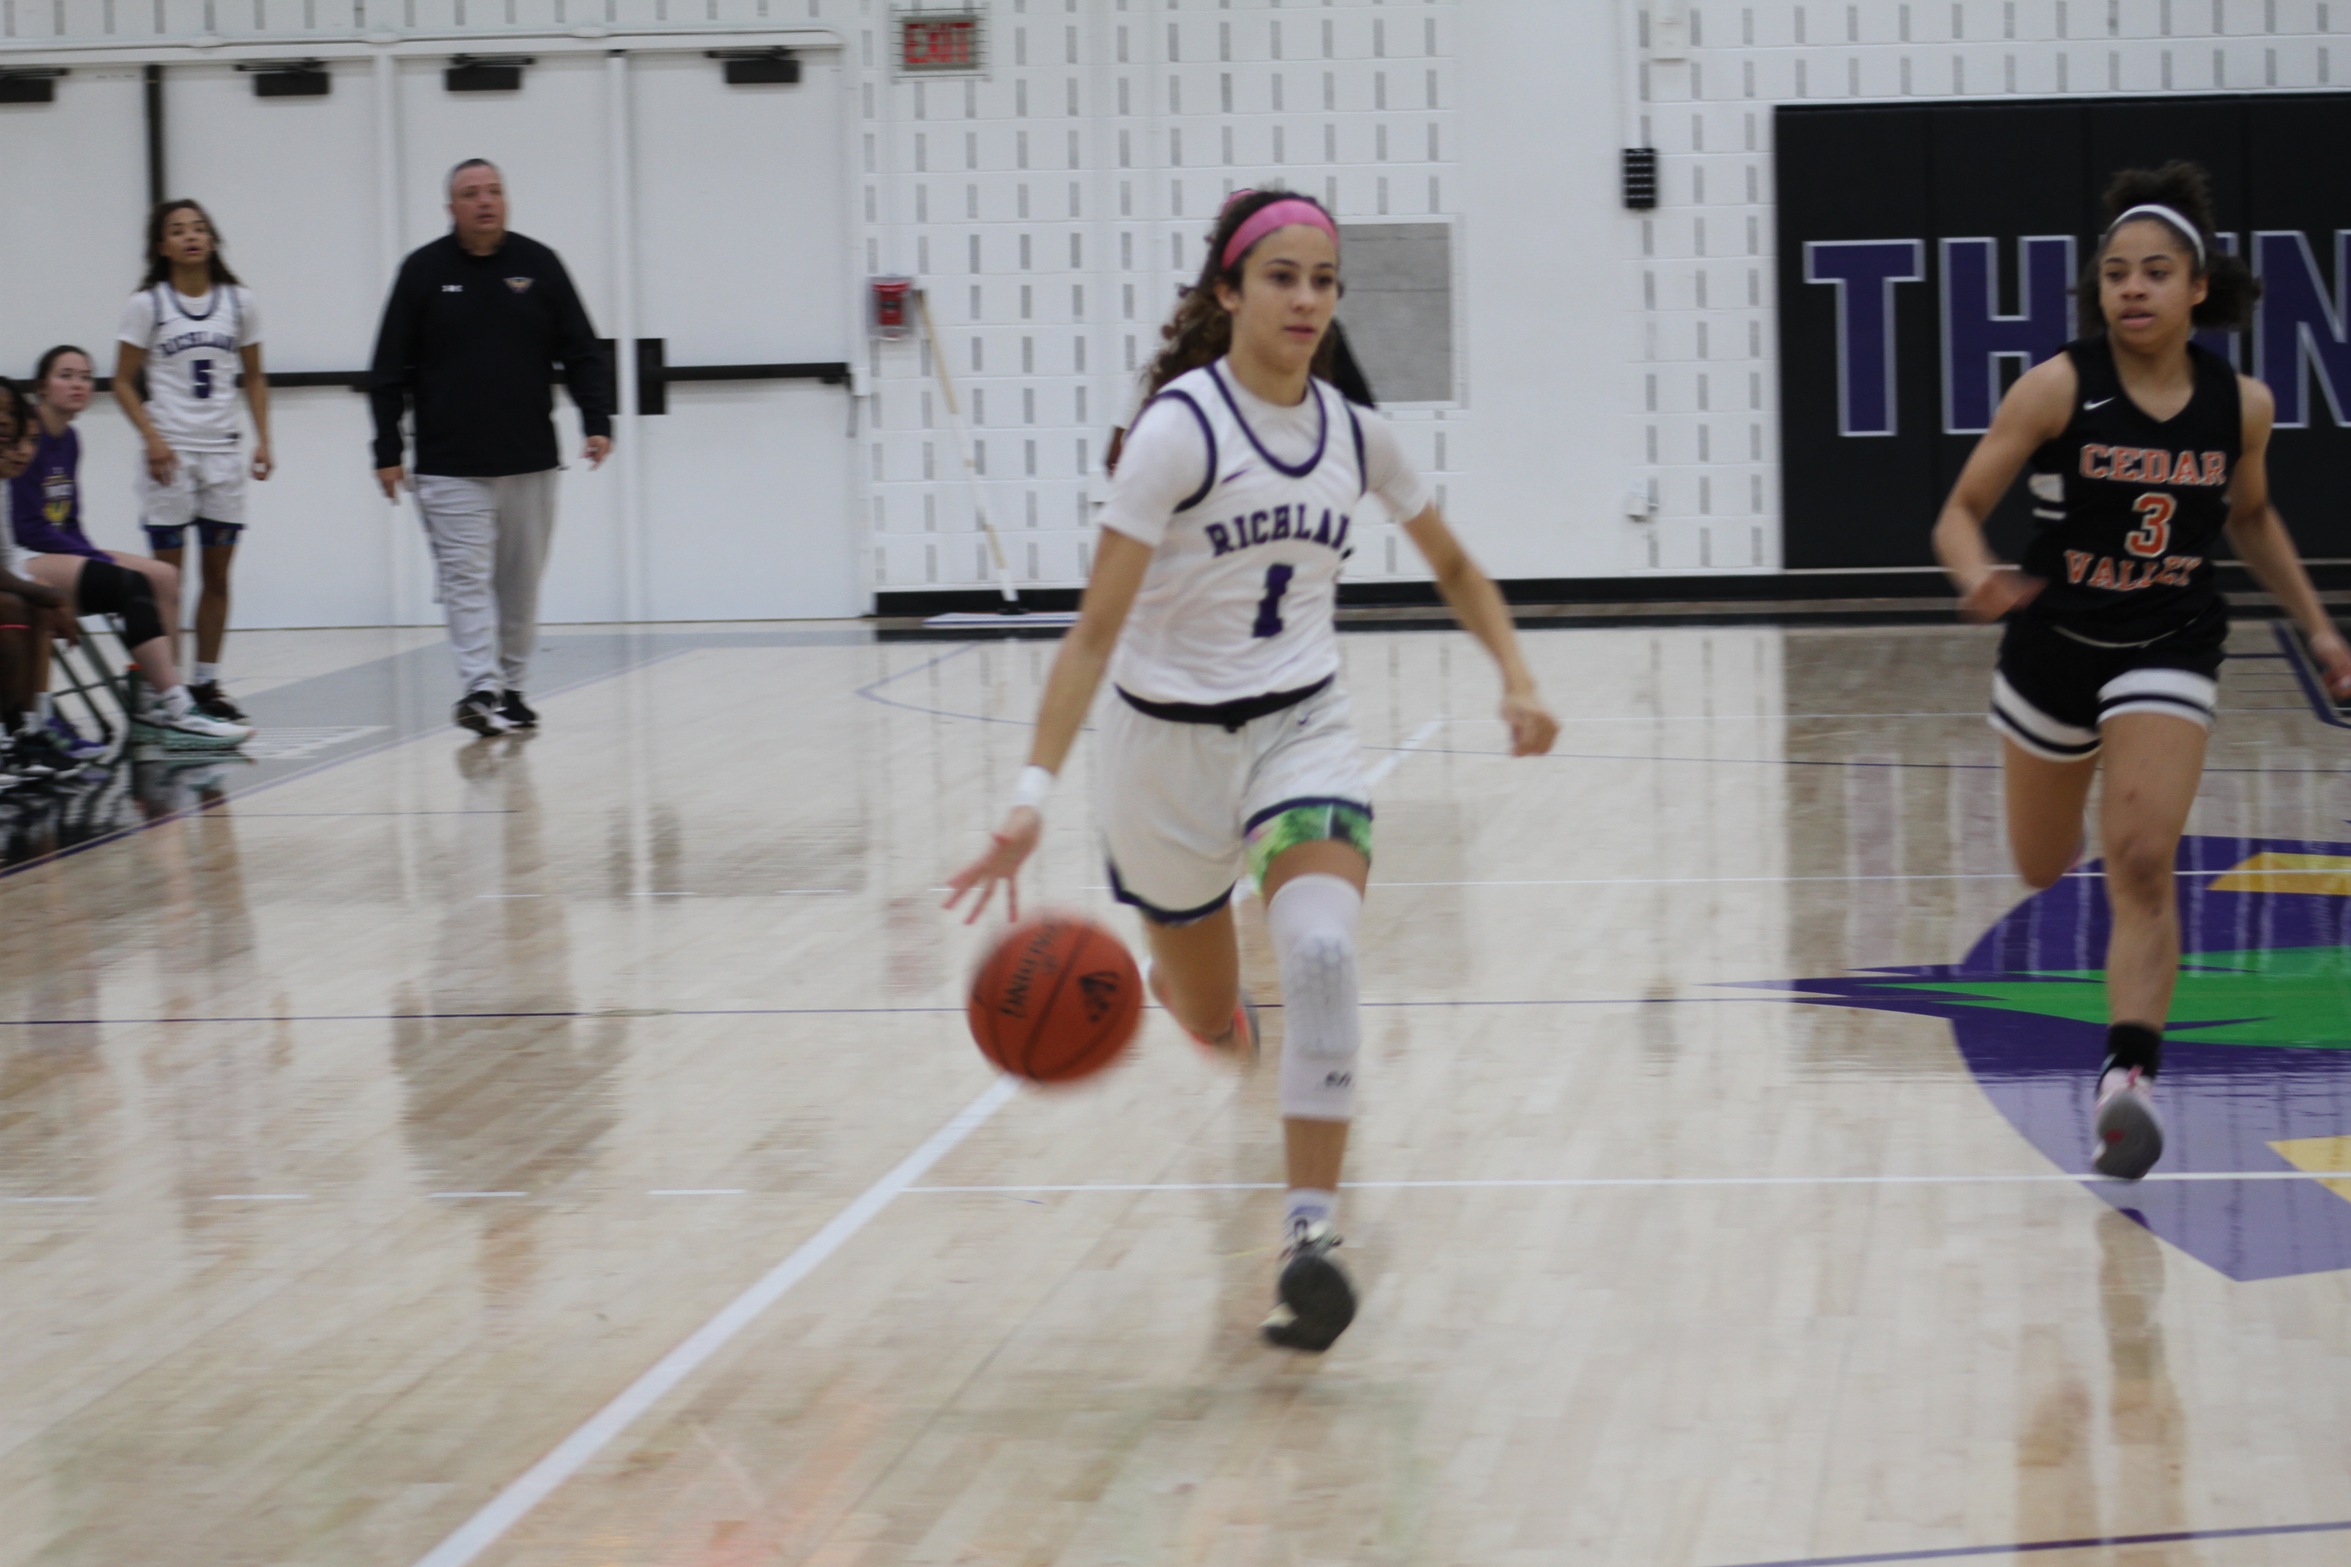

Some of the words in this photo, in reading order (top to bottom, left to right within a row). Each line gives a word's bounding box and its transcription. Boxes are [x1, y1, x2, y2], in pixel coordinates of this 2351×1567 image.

[904, 22, 976, 64] EXIT
[1803, 229, 2351, 437] THN
[190, 359, 213, 399] 5
[2079, 443, 2226, 486] CEDAR
[2124, 492, 2177, 558] 3
[2063, 549, 2202, 591] VALLEY
[1252, 563, 1294, 637] 1
